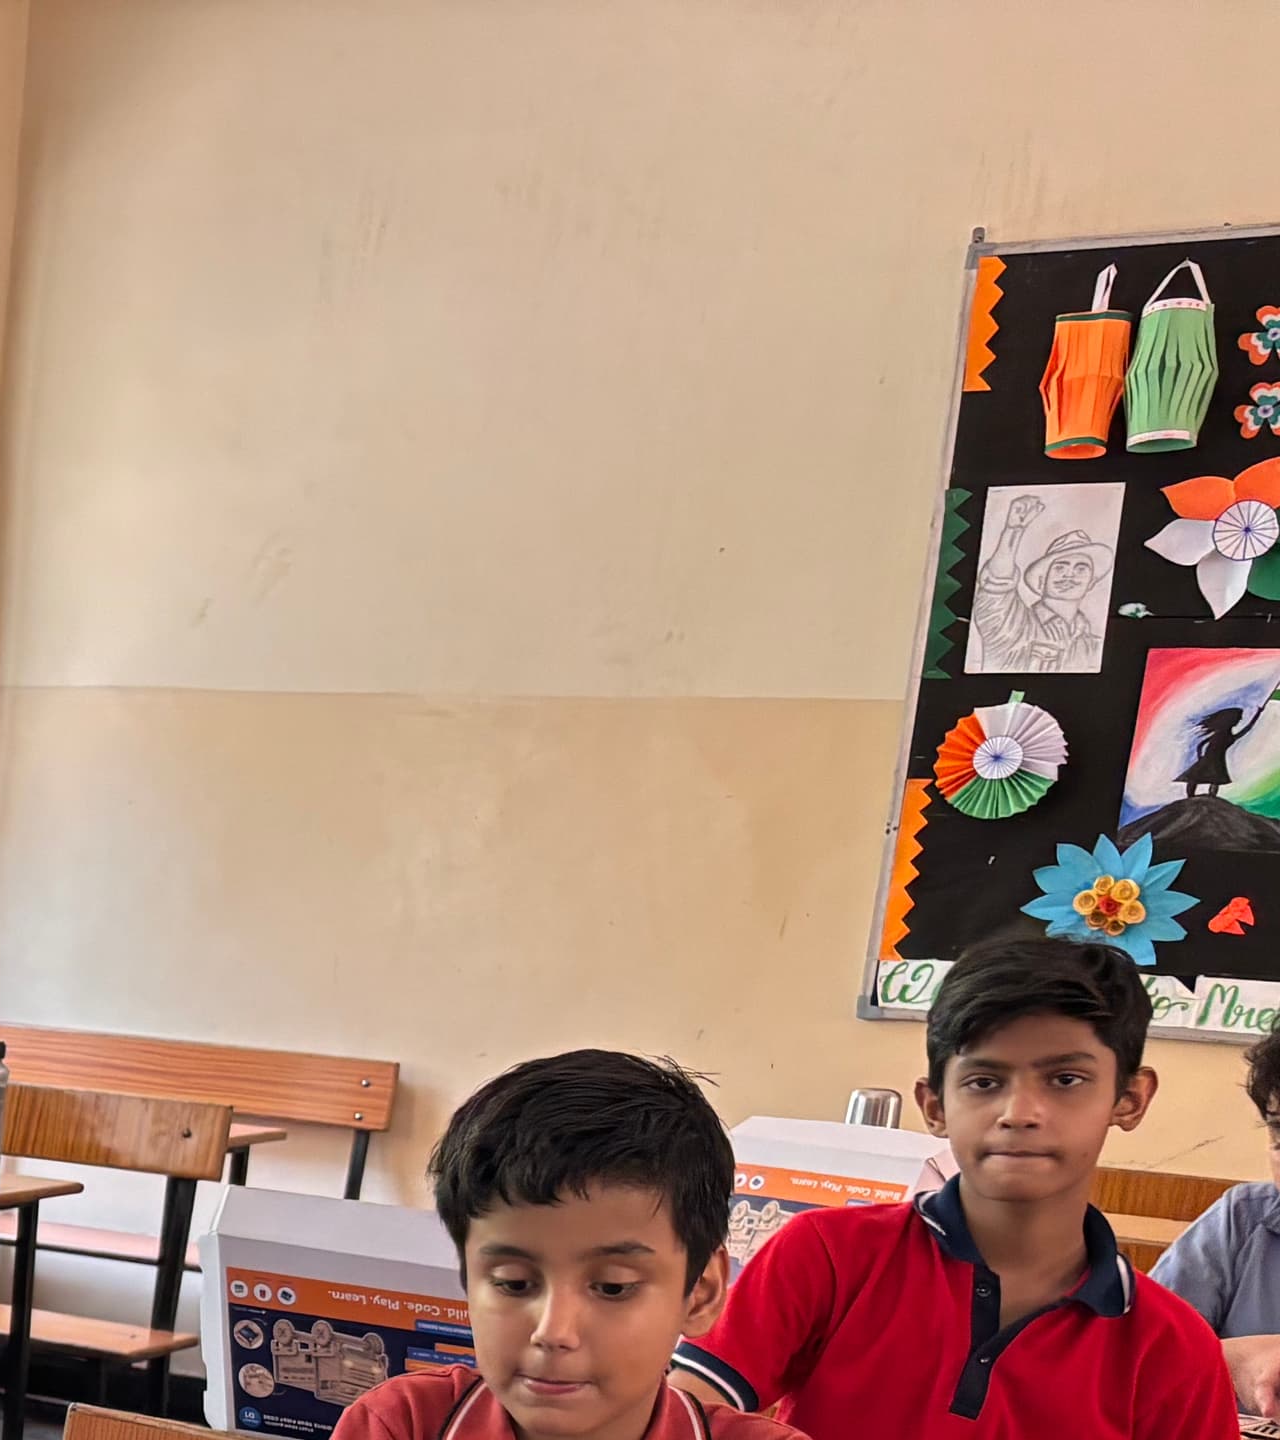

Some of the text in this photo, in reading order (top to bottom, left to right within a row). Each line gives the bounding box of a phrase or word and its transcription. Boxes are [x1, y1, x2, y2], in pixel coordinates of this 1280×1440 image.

[327, 1289, 367, 1305] Learn.
[368, 1295, 400, 1310] Play.
[403, 1300, 441, 1316] Code.
